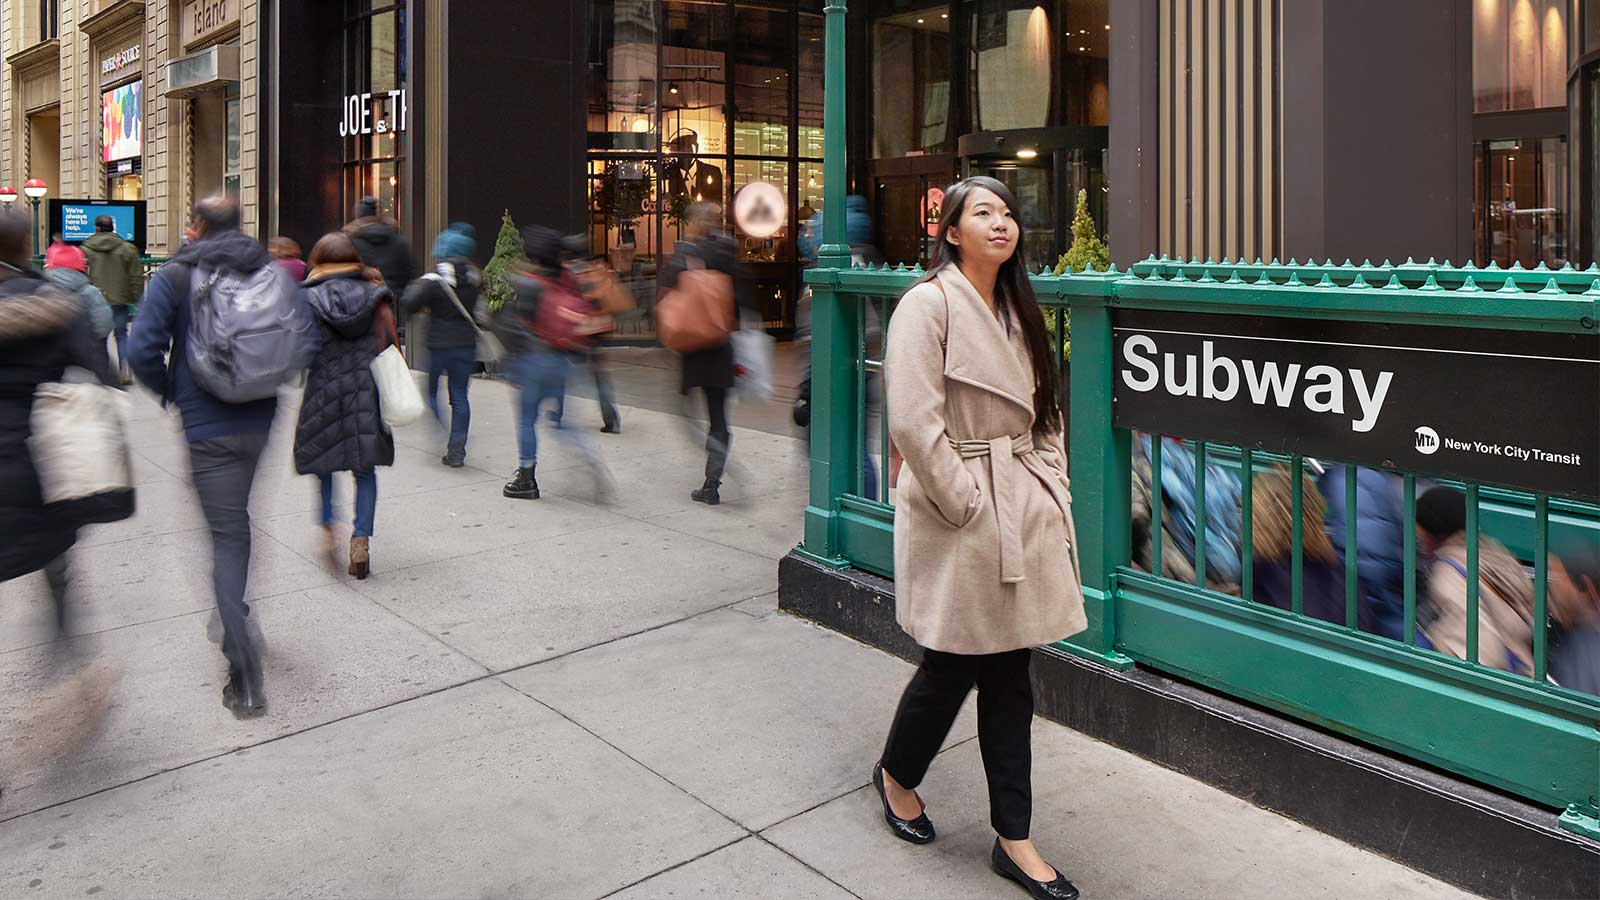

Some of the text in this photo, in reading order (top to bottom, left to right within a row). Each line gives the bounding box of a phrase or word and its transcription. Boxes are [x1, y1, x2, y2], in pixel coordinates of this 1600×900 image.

[194, 0, 226, 36] island
[340, 94, 371, 137] JOE
[377, 120, 387, 133] &
[1121, 334, 1394, 433] Subway
[1414, 431, 1581, 466] MTA New York City Transit
